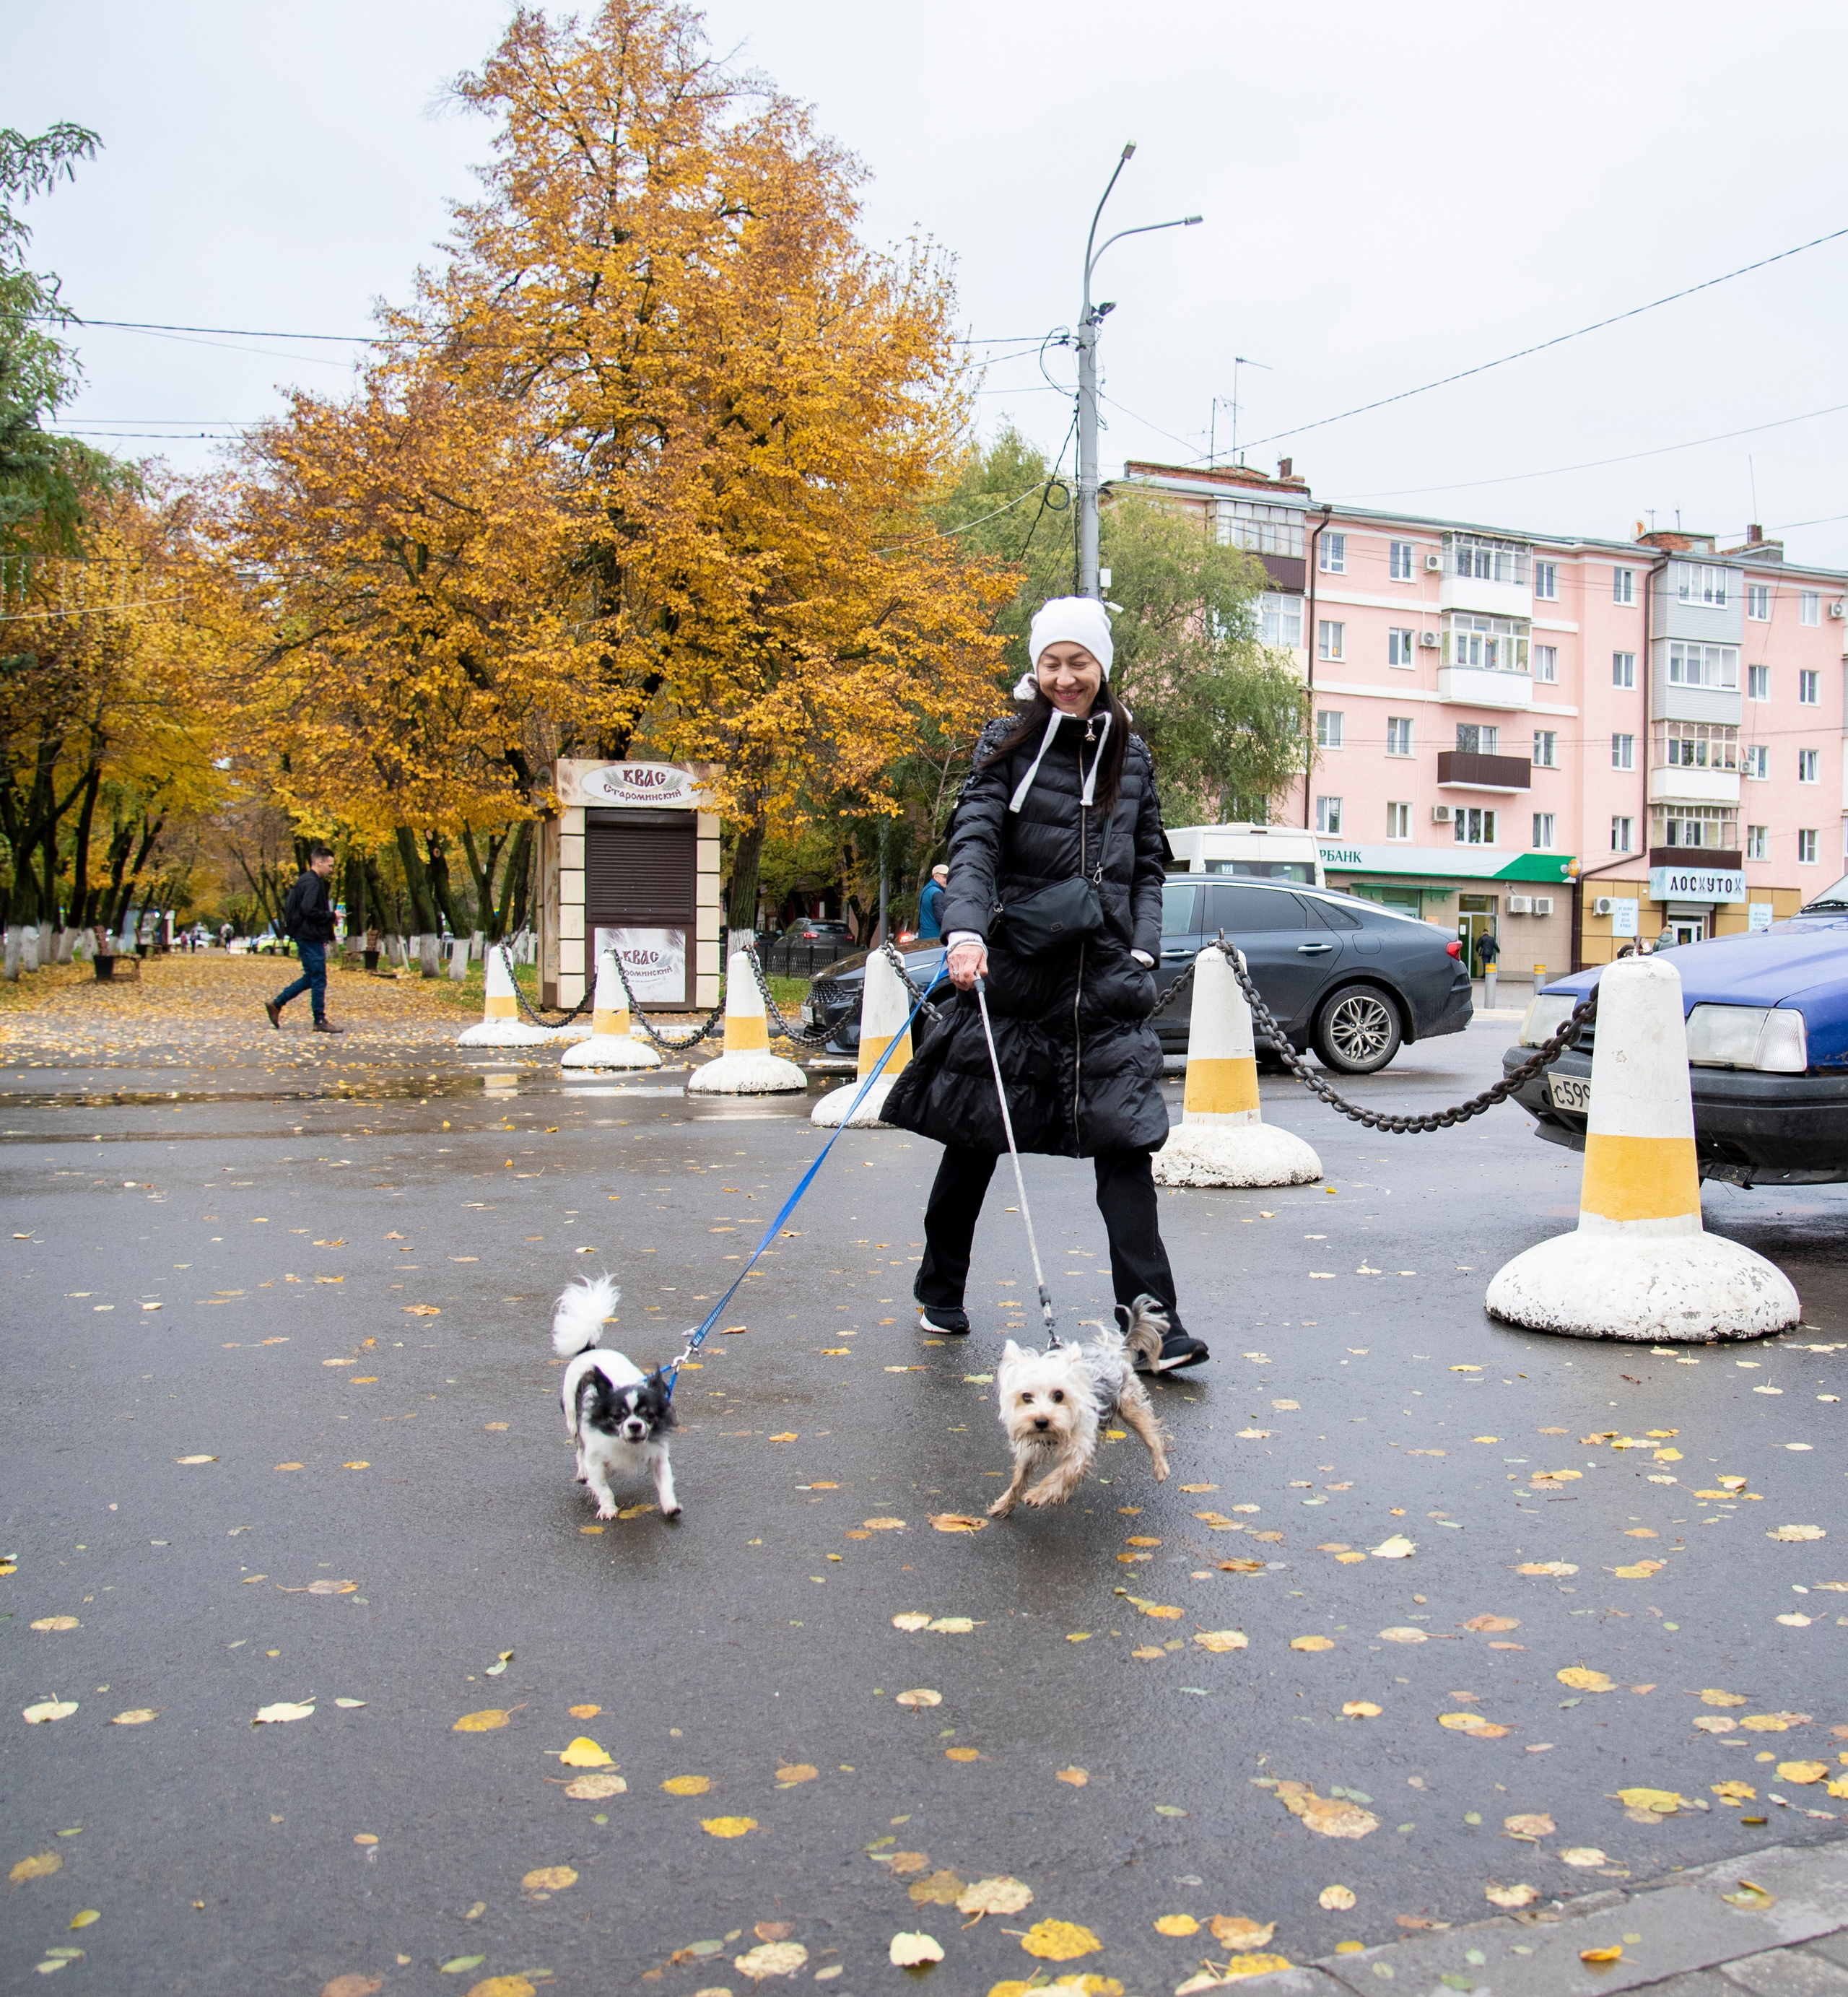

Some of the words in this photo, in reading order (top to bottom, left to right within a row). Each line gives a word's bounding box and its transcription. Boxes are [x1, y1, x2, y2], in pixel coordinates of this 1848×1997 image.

[623, 769, 666, 787] КВАС
[603, 784, 681, 801] Староминский
[1320, 850, 1361, 863] РБАНК
[622, 950, 659, 965] КВАС
[624, 966, 672, 977] роминский
